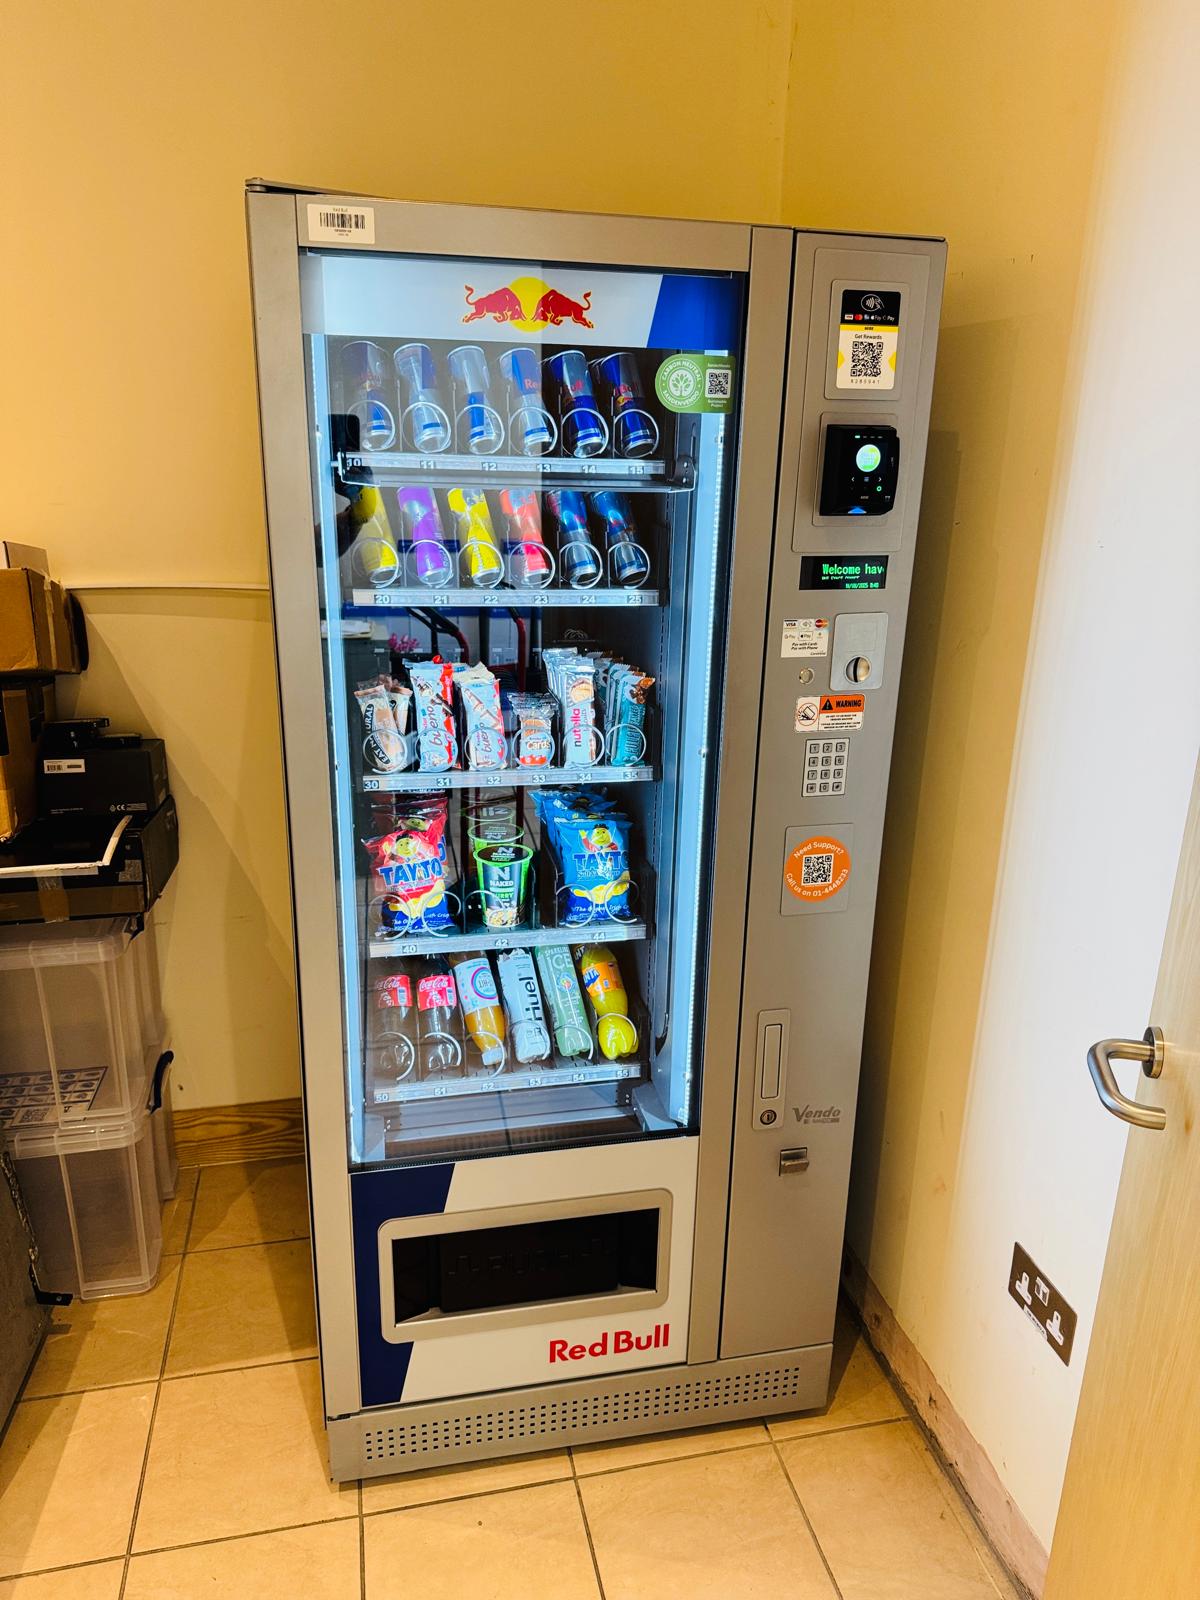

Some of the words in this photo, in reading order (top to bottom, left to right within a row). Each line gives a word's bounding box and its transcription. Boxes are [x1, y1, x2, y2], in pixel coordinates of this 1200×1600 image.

[420, 461, 435, 470] 11
[482, 463, 497, 471] 12
[537, 464, 550, 472] 13
[582, 465, 596, 473] 14
[630, 466, 644, 474] 15
[822, 563, 860, 575] Welcome
[864, 563, 884, 574] hav
[375, 596, 390, 604] 20
[434, 596, 448, 604] 21
[484, 596, 498, 604] 22
[534, 596, 548, 604] 23
[582, 596, 596, 604] 24
[628, 596, 642, 604] 25
[836, 700, 862, 708] WARNING
[426, 706, 443, 746] bueno
[570, 708, 582, 748] nutella
[480, 722, 492, 753] bueno
[375, 748, 389, 762] EAT
[437, 778, 450, 786] 31
[487, 776, 500, 784] 32
[532, 775, 546, 783] 33
[579, 774, 592, 782] 34
[364, 780, 378, 790] 30
[794, 844, 812, 858] Need
[812, 842, 844, 855] Support?
[378, 858, 444, 886] TAYTO
[494, 866, 510, 880] N
[786, 872, 796, 887] Call
[794, 885, 802, 893] us
[592, 932, 606, 940] 44
[496, 939, 508, 947] 42
[403, 945, 416, 953] 40
[518, 976, 542, 1021] Huel
[574, 1074, 585, 1082] 54
[616, 1070, 628, 1078] 55
[530, 1078, 542, 1086] 53
[434, 1088, 446, 1096] 51
[375, 1094, 388, 1102] 50
[792, 1104, 840, 1122] Vendo
[550, 1332, 608, 1364] Red
[614, 1324, 670, 1354] Bull
